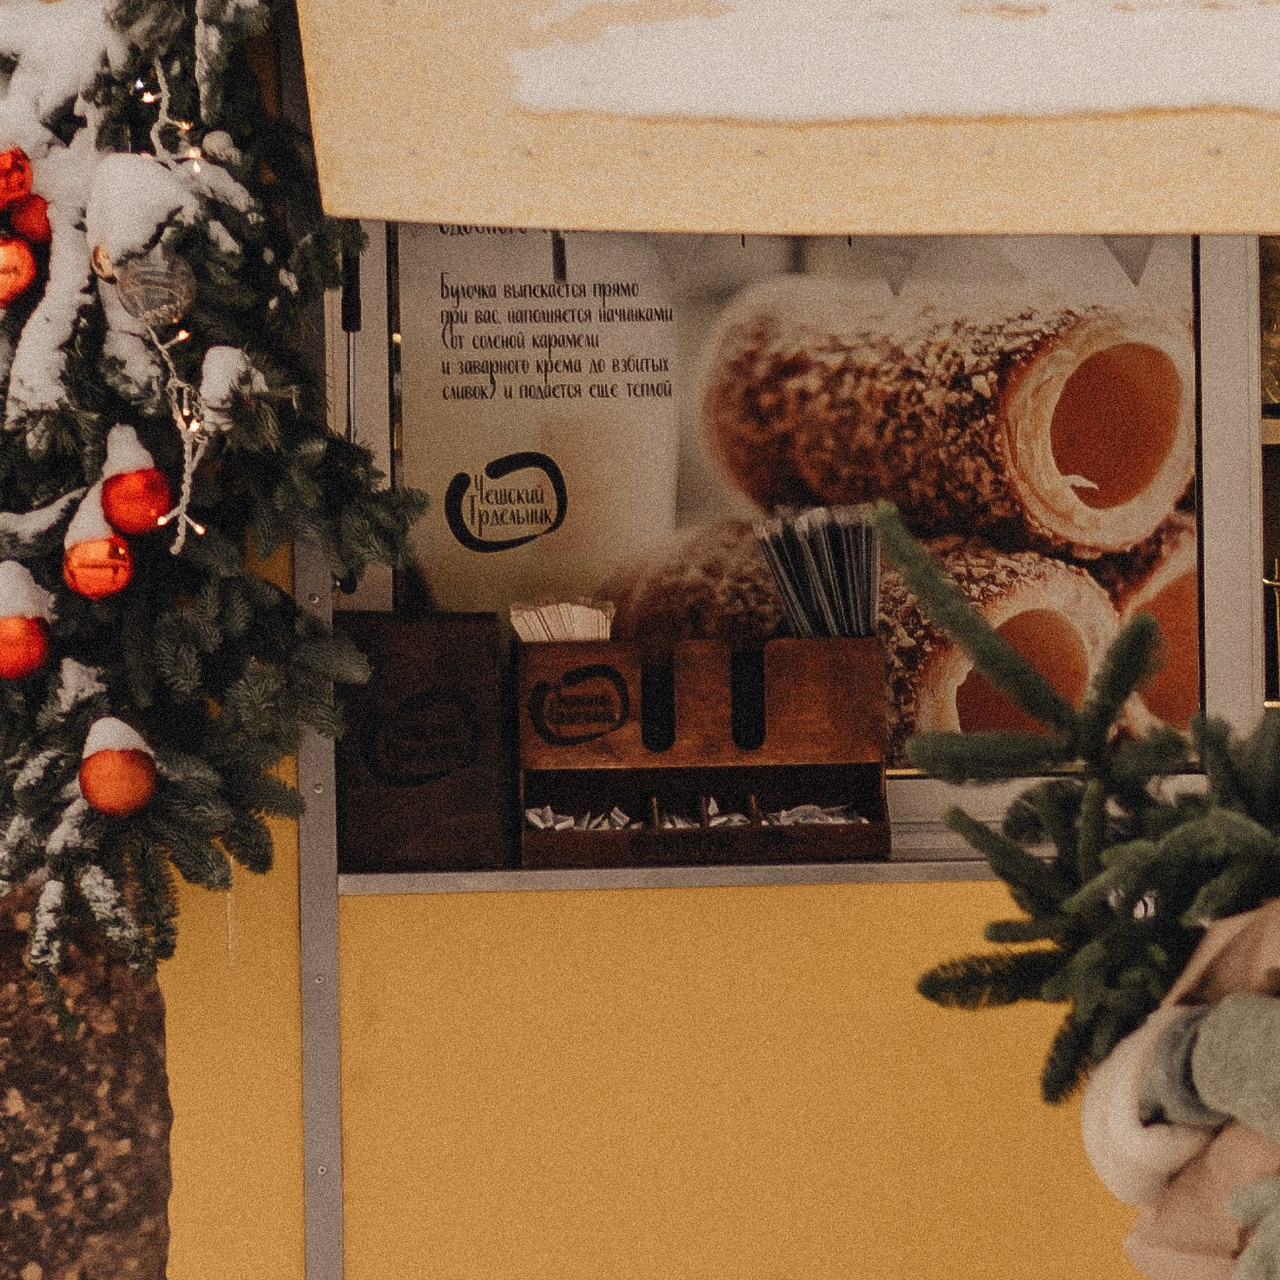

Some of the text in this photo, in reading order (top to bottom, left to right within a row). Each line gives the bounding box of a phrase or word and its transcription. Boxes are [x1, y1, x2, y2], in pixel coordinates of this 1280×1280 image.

[440, 272, 640, 307] Булочка выпекается прямо
[440, 308, 468, 337] при
[507, 307, 593, 324] наполняется
[598, 305, 674, 324] начинками
[532, 333, 600, 360] карамели
[441, 353, 670, 384] и заварного крема до взбитых
[504, 384, 513, 400] и
[519, 383, 582, 400] подается
[588, 383, 619, 400] еще
[626, 379, 674, 399] теплой
[474, 473, 545, 505] Чешский
[468, 494, 553, 537] Трдельник
